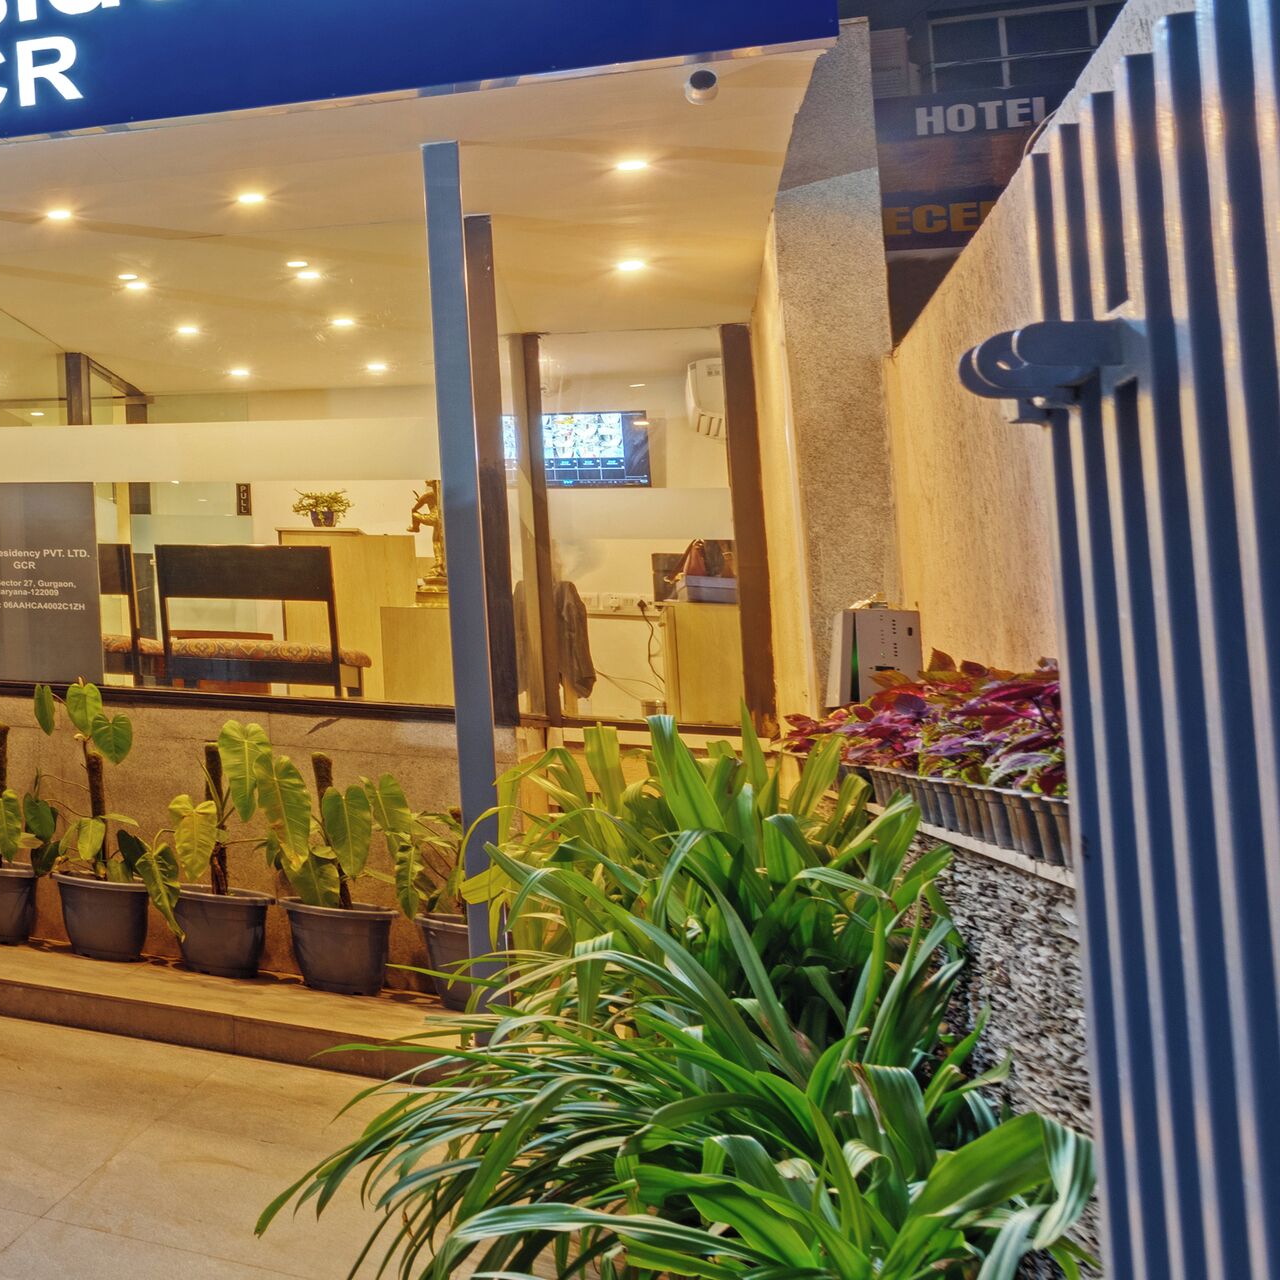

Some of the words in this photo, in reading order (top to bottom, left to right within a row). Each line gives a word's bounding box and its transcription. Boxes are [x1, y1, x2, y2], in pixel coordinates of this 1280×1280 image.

[240, 485, 248, 513] PULL
[43, 549, 65, 558] PVT.
[67, 549, 91, 558] LTD.
[13, 561, 37, 570] GCR
[37, 579, 77, 589] Gurgaon,
